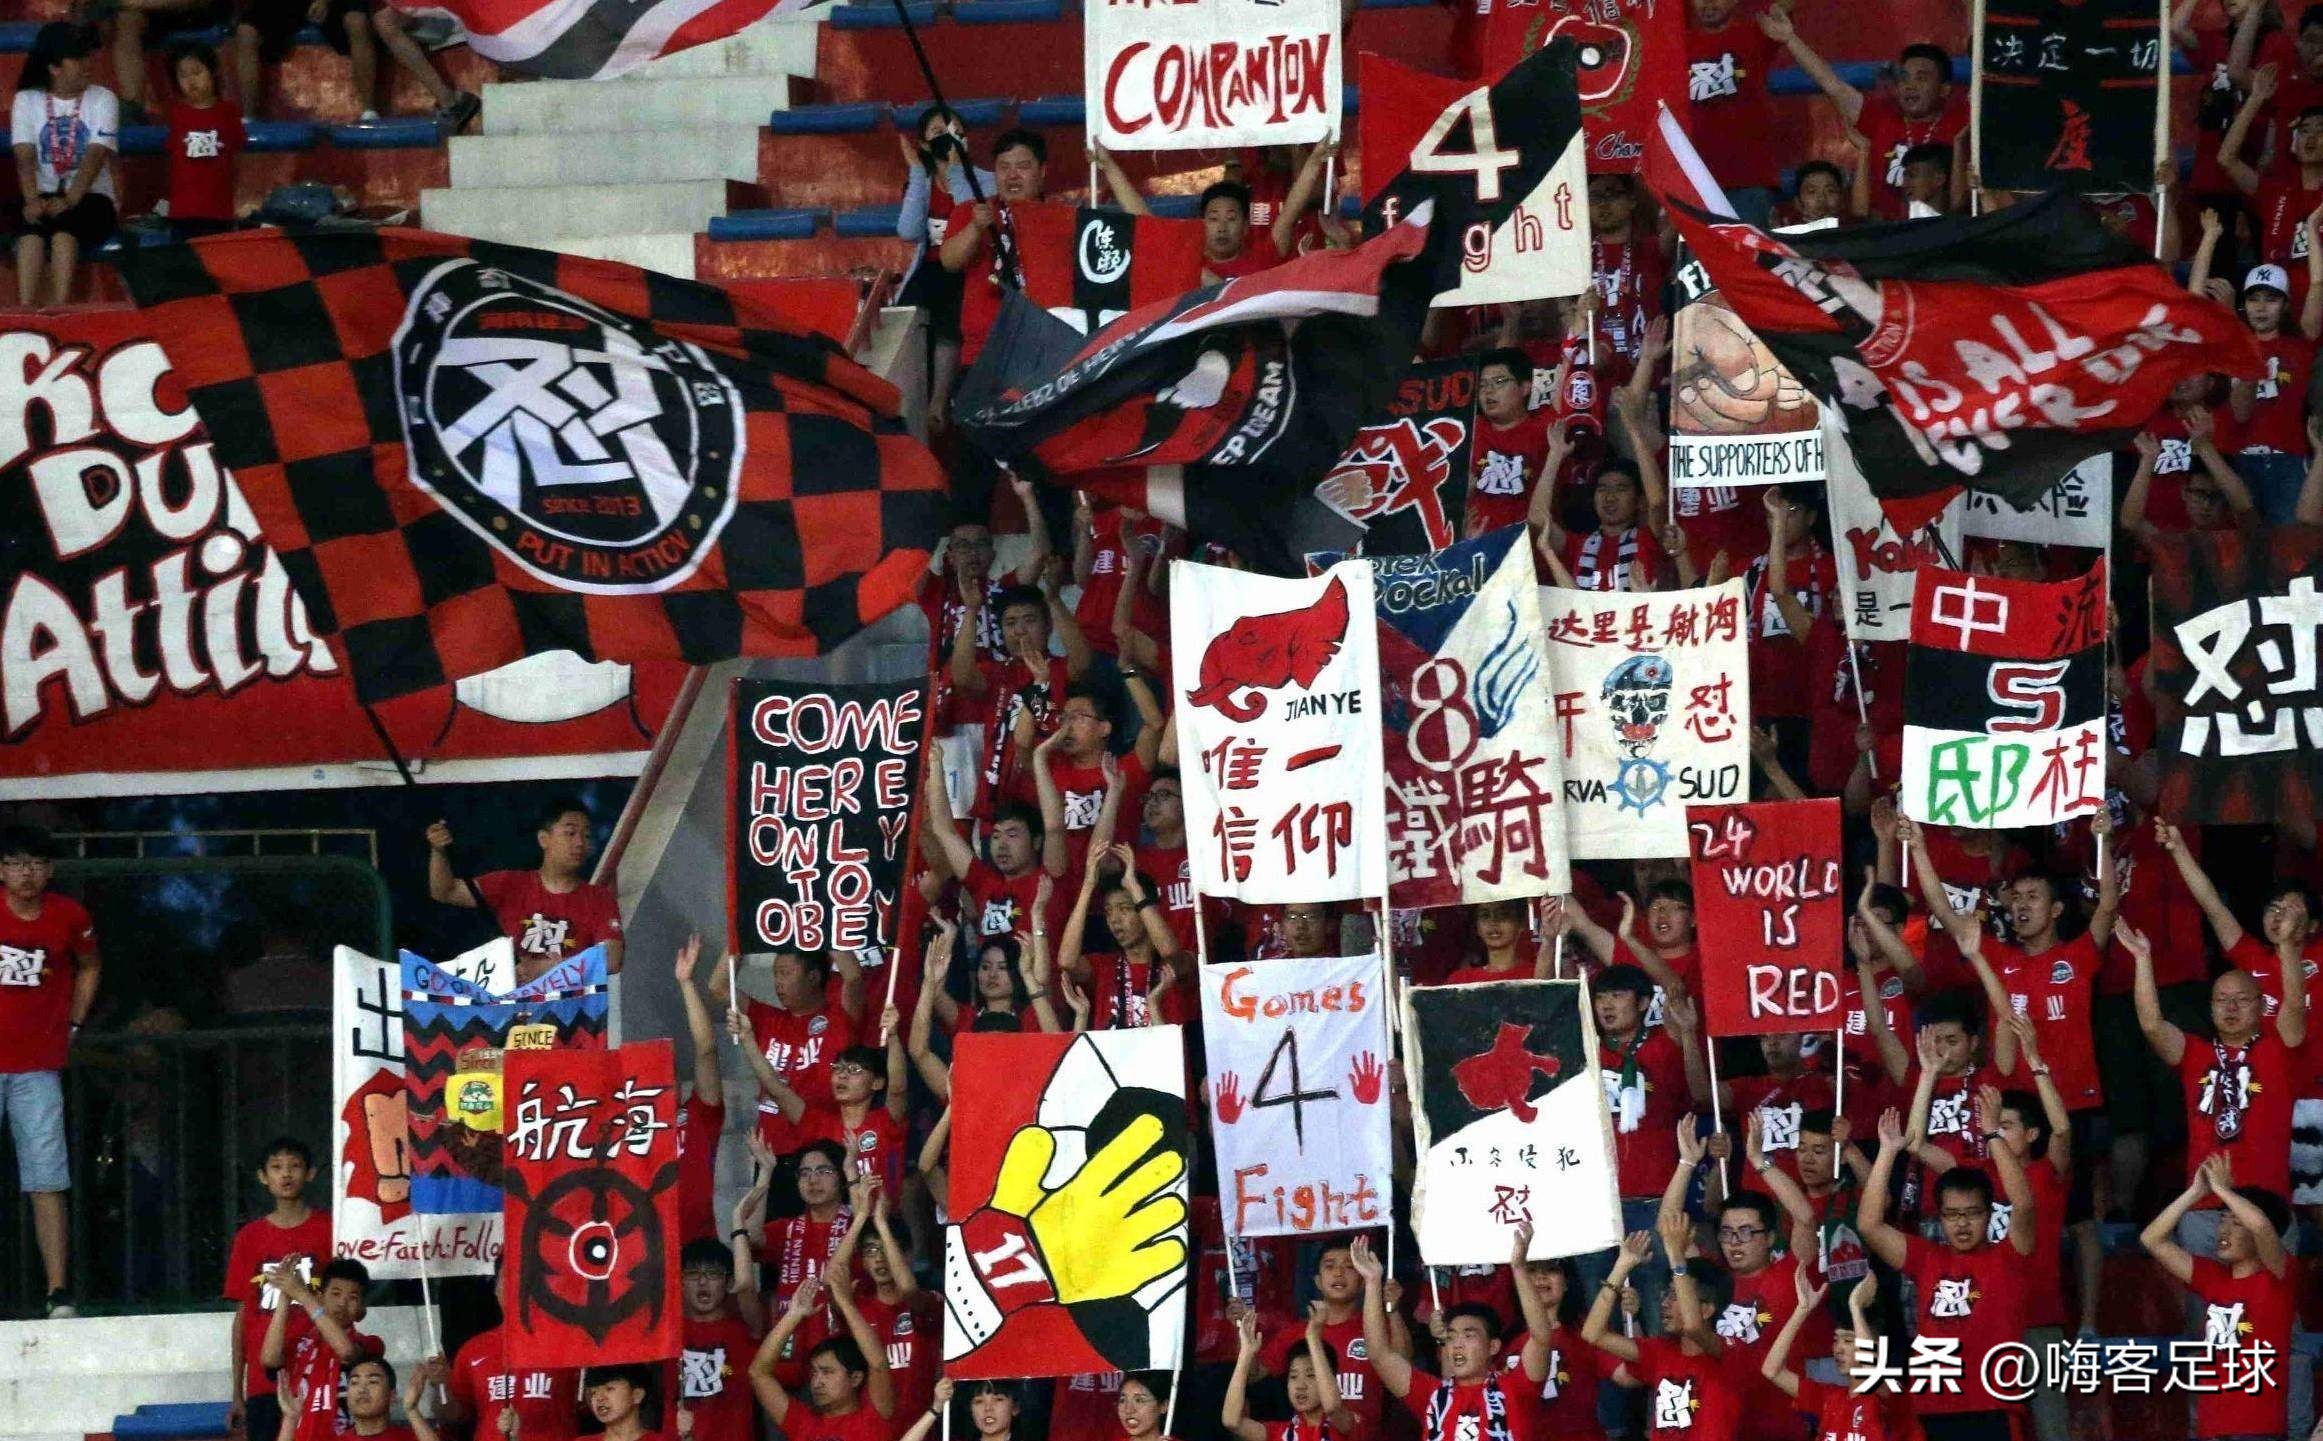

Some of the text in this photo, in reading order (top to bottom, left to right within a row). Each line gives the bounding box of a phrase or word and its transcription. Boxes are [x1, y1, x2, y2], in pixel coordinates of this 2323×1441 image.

[1992, 33, 2160, 70] 决定一切
[1104, 34, 1331, 134] COMPANION
[1409, 86, 1519, 200] 4
[1382, 182, 1574, 273] fght
[1954, 301, 2095, 395] ALL
[1670, 445, 1695, 478] THE
[1698, 441, 1791, 477] SUPPORTERS
[1796, 438, 1812, 472] OF
[517, 530, 575, 570] PUT
[582, 550, 611, 577] IN
[2174, 576, 2323, 758] 怼
[752, 690, 921, 754] COME
[1406, 658, 1480, 773] 8
[751, 758, 909, 821] HERE
[1202, 734, 1343, 790] 唯一
[1679, 764, 1739, 800] SUD
[750, 812, 907, 872] ONLY
[1212, 802, 1353, 882] 信仰
[1692, 816, 1752, 858] 24
[787, 861, 872, 906] TO
[1722, 859, 1840, 900] WORLD
[756, 888, 896, 951] OBEY
[1763, 904, 1799, 946] IS
[1747, 964, 1840, 1019] RED
[513, 1031, 553, 1048] SINCE
[507, 1078, 669, 1161] 航海
[1250, 1025, 1341, 1157] 4
[1233, 1163, 1380, 1235] Fight
[1488, 1184, 1533, 1225] 怼
[972, 1231, 1050, 1290] 17
